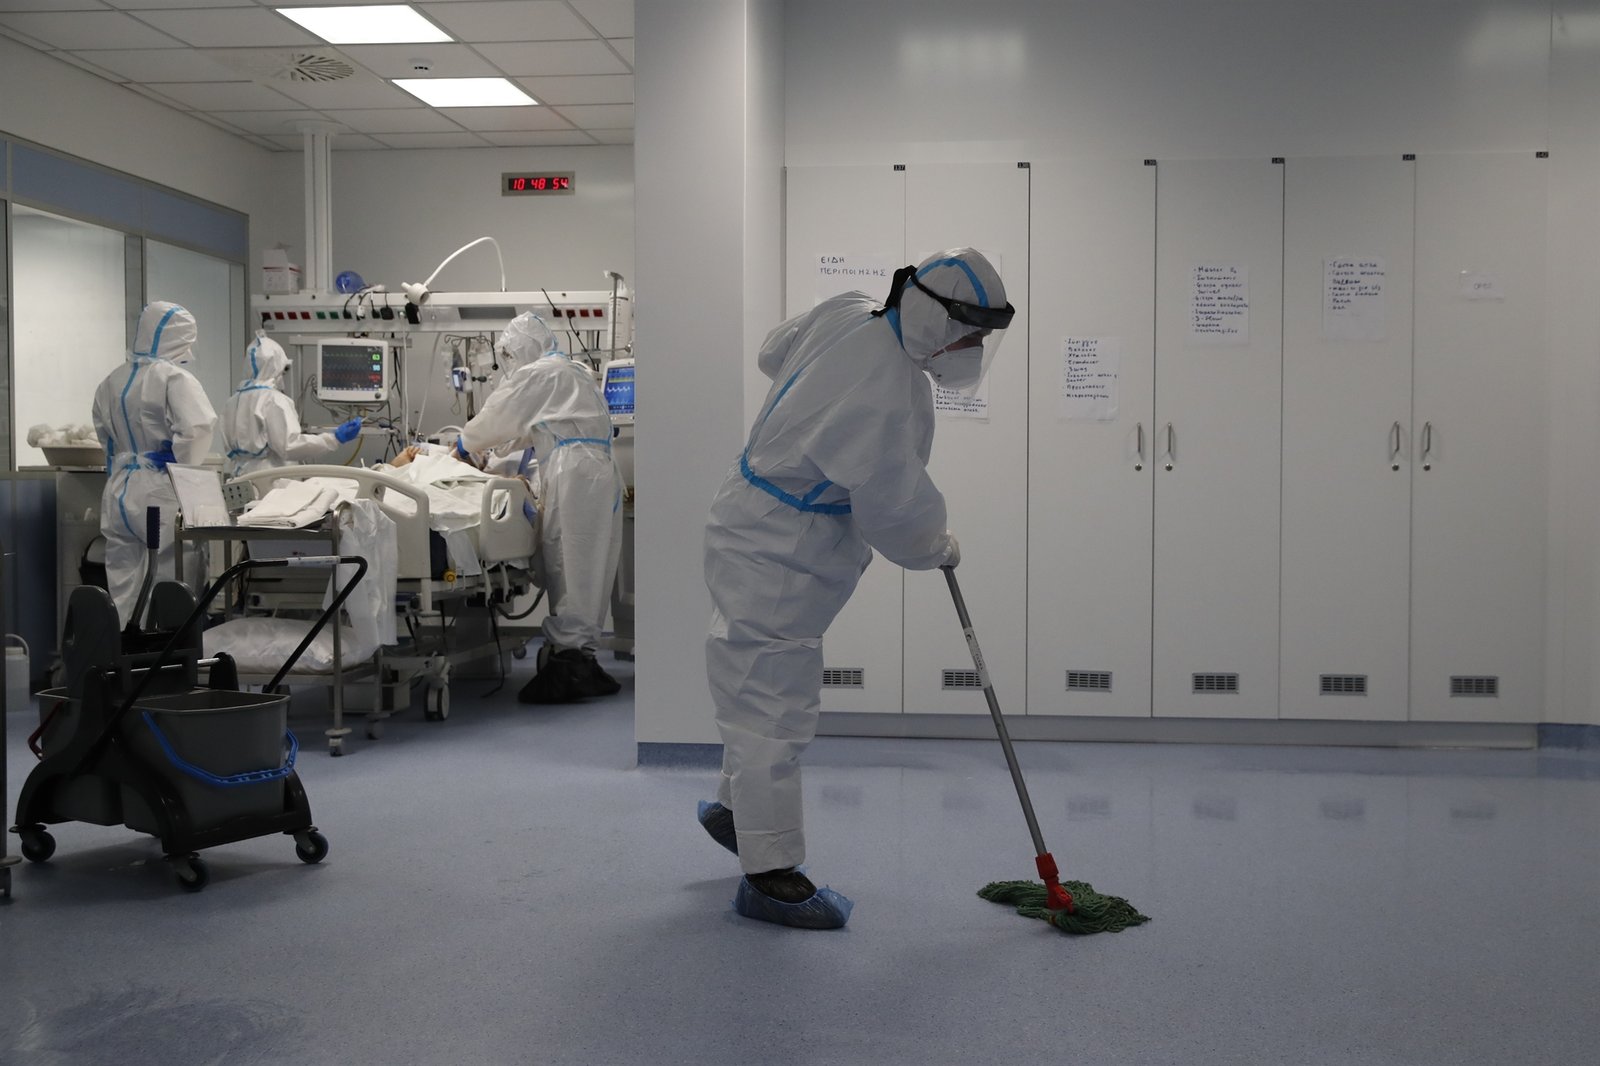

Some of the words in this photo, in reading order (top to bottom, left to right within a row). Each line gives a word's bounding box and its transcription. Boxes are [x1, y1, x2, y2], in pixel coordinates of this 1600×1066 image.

[513, 177, 525, 190] 10
[530, 177, 546, 190] 48
[552, 177, 568, 190] 54
[820, 256, 845, 264] ΕΙΔΗ
[820, 267, 887, 277] ΠΕΡΙΠΟΙΗΣΗΣ
